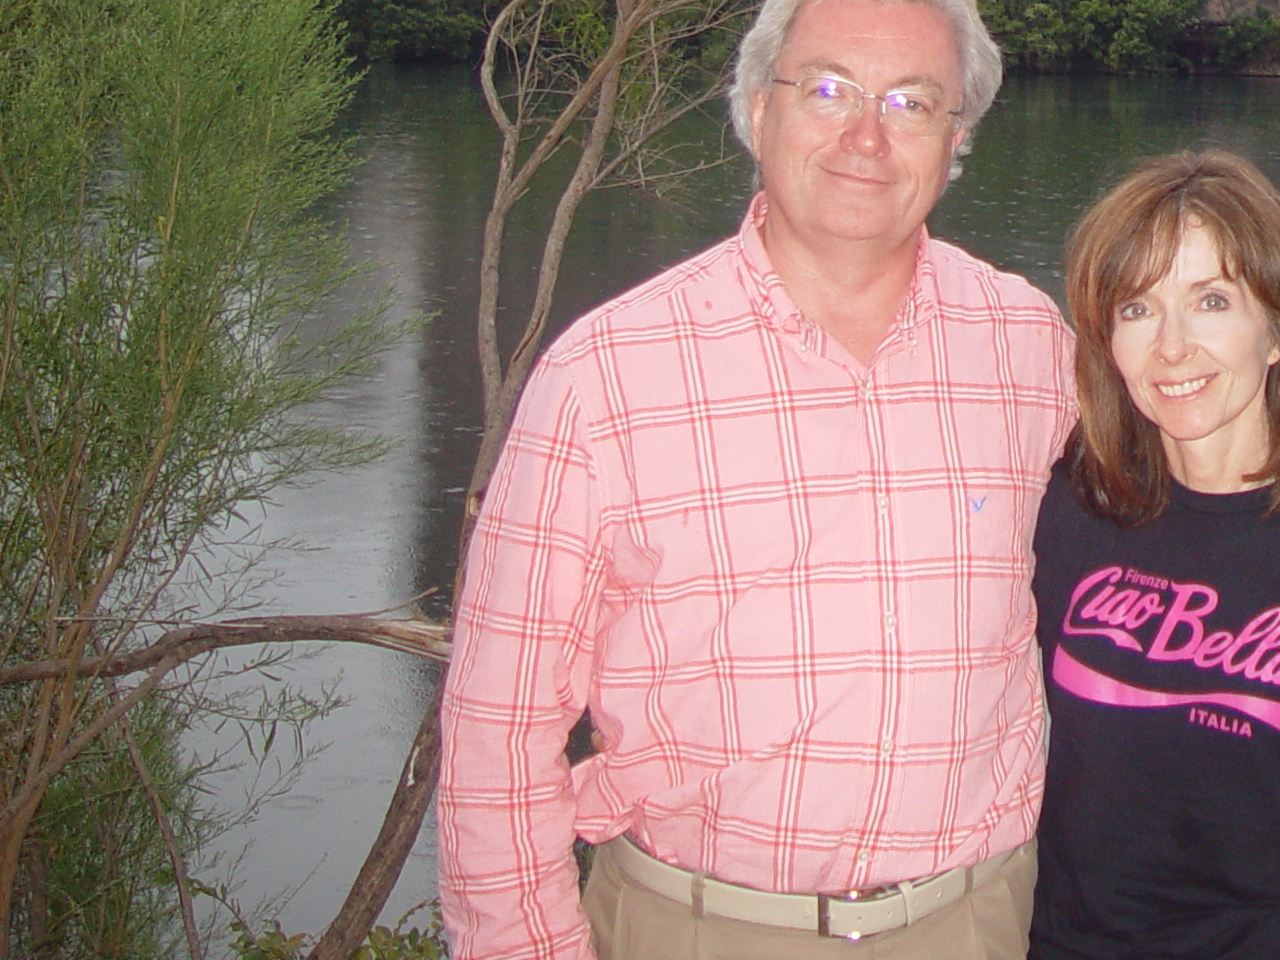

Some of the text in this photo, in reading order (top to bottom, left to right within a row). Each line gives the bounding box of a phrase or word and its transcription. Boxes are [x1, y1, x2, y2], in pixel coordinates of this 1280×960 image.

[1125, 569, 1168, 590] Firenze
[1063, 566, 1165, 652] Ciao
[1189, 708, 1252, 737] ITALIA
